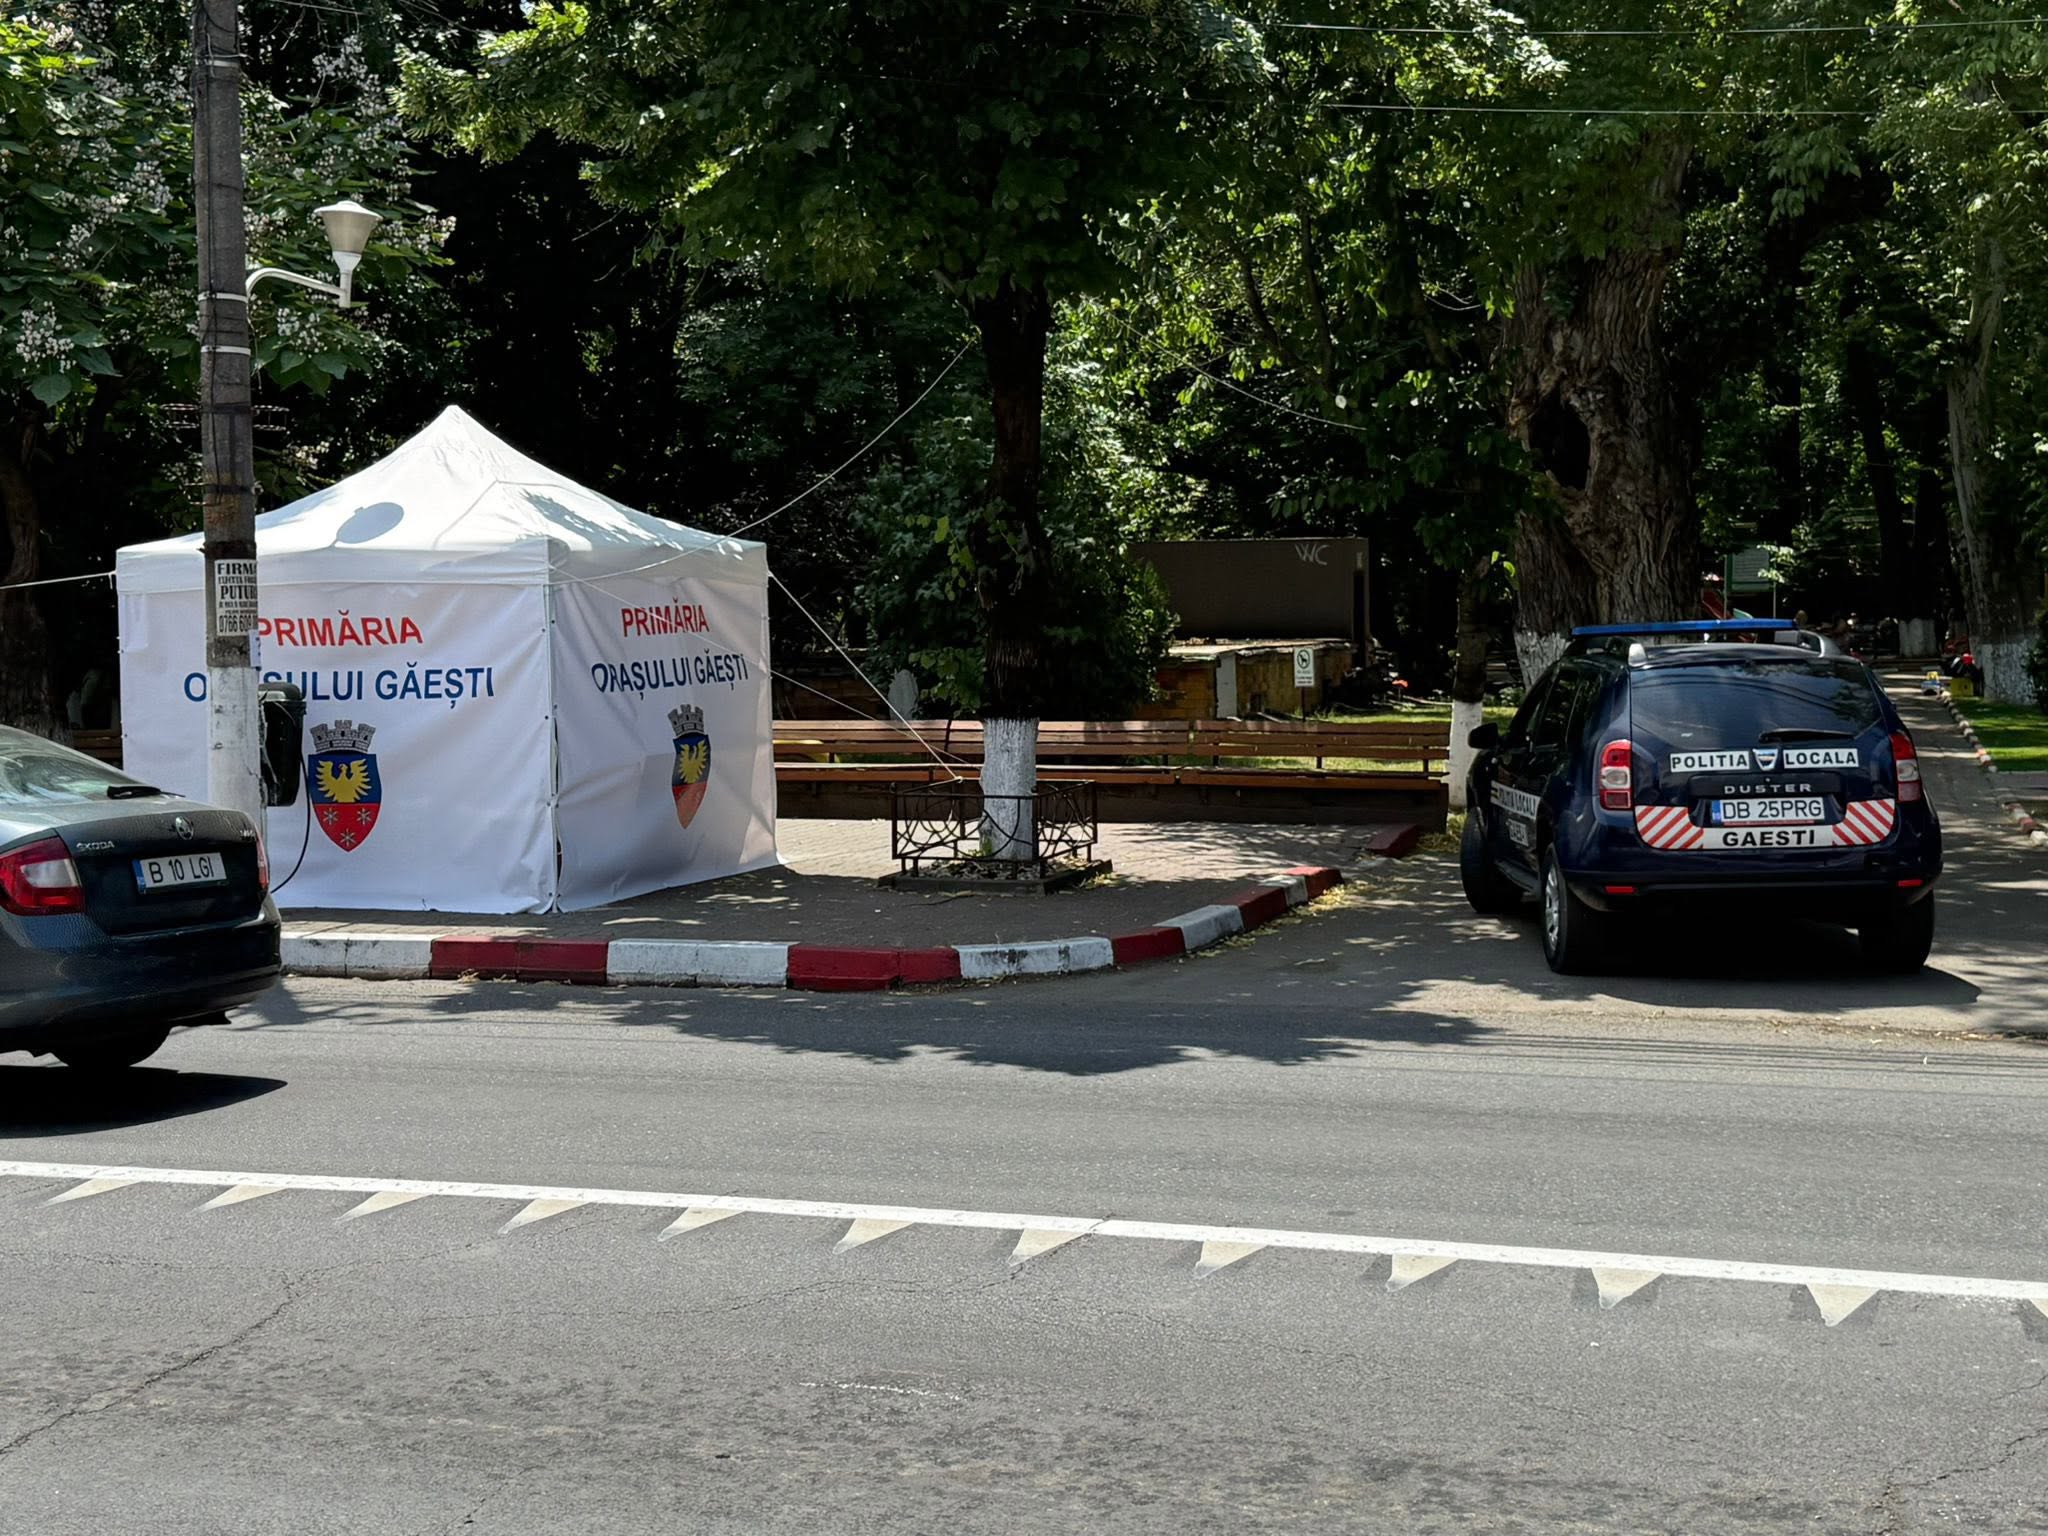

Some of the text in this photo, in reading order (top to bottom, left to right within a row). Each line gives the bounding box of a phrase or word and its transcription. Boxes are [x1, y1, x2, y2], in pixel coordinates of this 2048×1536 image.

[1294, 543, 1330, 566] WC
[621, 597, 711, 637] PRIMĂRIA
[374, 661, 495, 709] GĂEȘTI
[591, 648, 749, 700] ORAȘULUI GĂEȘTI
[1672, 751, 1857, 769] POLITIA LOCALA
[1724, 783, 1812, 794] DUSTER
[1723, 800, 1822, 819] DB 25PRG
[1722, 830, 1815, 847] GAESTI
[149, 855, 214, 883] B 10 LGI
